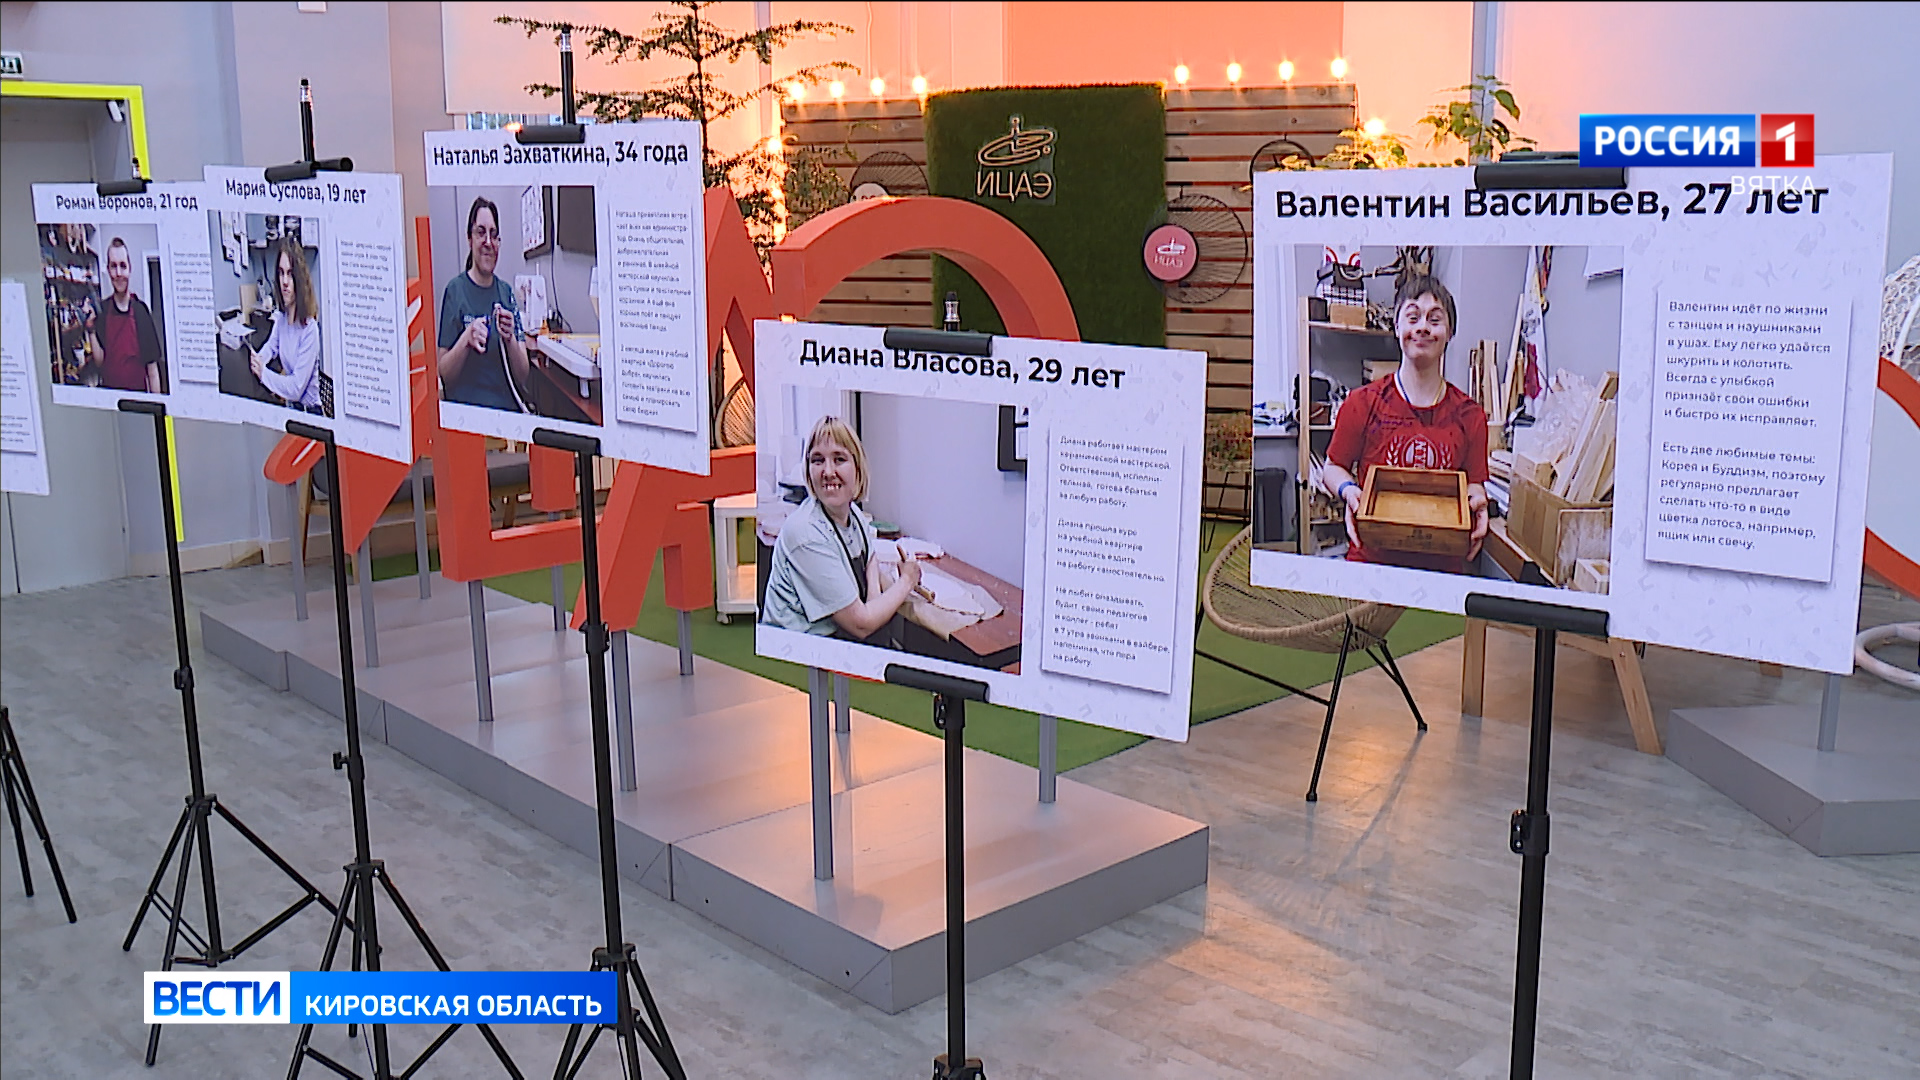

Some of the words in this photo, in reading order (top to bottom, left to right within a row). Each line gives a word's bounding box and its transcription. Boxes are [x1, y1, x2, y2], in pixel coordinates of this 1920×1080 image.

[433, 146, 499, 166] Наталья
[502, 142, 611, 167] Захваткина,
[614, 140, 639, 162] 34
[643, 143, 689, 166] года
[225, 178, 266, 199] Мария
[269, 181, 325, 204] Суслова,
[327, 183, 340, 202] 19
[343, 188, 367, 204] лет
[976, 171, 1052, 202] ИЦАЭ
[55, 194, 95, 210] Роман
[98, 195, 157, 213] Воронов,
[159, 193, 172, 209] 21
[175, 195, 198, 211] год
[1276, 190, 1450, 218] Валентин
[1464, 188, 1670, 222] Васильев,
[1683, 182, 1733, 215] 27
[1745, 187, 1829, 215] лет
[1669, 301, 1728, 312] Валентин
[1732, 303, 1761, 314] идёт
[1765, 305, 1781, 314] по
[1784, 305, 1827, 316] жизни
[1668, 321, 1674, 329] с
[1678, 321, 1722, 331] танцем
[1726, 323, 1733, 331] и
[1737, 323, 1820, 334] наушниками
[1677, 339, 1710, 349] ушах.
[1714, 338, 1738, 351] Ему
[1740, 341, 1776, 351] легко
[1779, 341, 1830, 353] удаётся
[799, 338, 885, 369] Диана
[893, 346, 1020, 384] Власова,
[1028, 356, 1063, 383] 29
[1070, 368, 1126, 389] лет
[1667, 355, 1718, 367] шкурить
[1722, 358, 1729, 367] и
[1733, 359, 1792, 369] колотить.
[1666, 371, 1707, 383] Всегда
[1710, 376, 1716, 384] с
[1720, 375, 1774, 387] улыбкой
[1665, 391, 1721, 403] признаёт
[1724, 395, 1754, 405] свои
[1757, 395, 1809, 407] ошибки
[1664, 409, 1671, 417] и
[1675, 407, 1719, 421] быстро
[1722, 413, 1736, 421] их
[1740, 413, 1816, 427] исправляет.
[1663, 441, 1688, 454] Есть
[1690, 445, 1712, 456] две
[1715, 447, 1775, 460] любимые
[1779, 453, 1815, 463] темы:
[1662, 459, 1697, 471] Корея
[1701, 464, 1708, 472] и
[1712, 463, 1768, 479] Буддизм,
[1771, 471, 1825, 486] поэтому
[1660, 479, 1724, 492] регулярно
[1727, 485, 1799, 499] предлагает
[1659, 495, 1706, 507] сделать
[1708, 500, 1746, 512] что-то
[1749, 505, 1756, 513] в
[1759, 505, 1790, 517] виде
[1659, 513, 1698, 524] цветка
[1701, 517, 1744, 531] лотоса,
[1748, 522, 1815, 539] например,
[1658, 531, 1689, 541] ящик
[1692, 533, 1715, 543] или
[1718, 537, 1754, 550] свечу.
